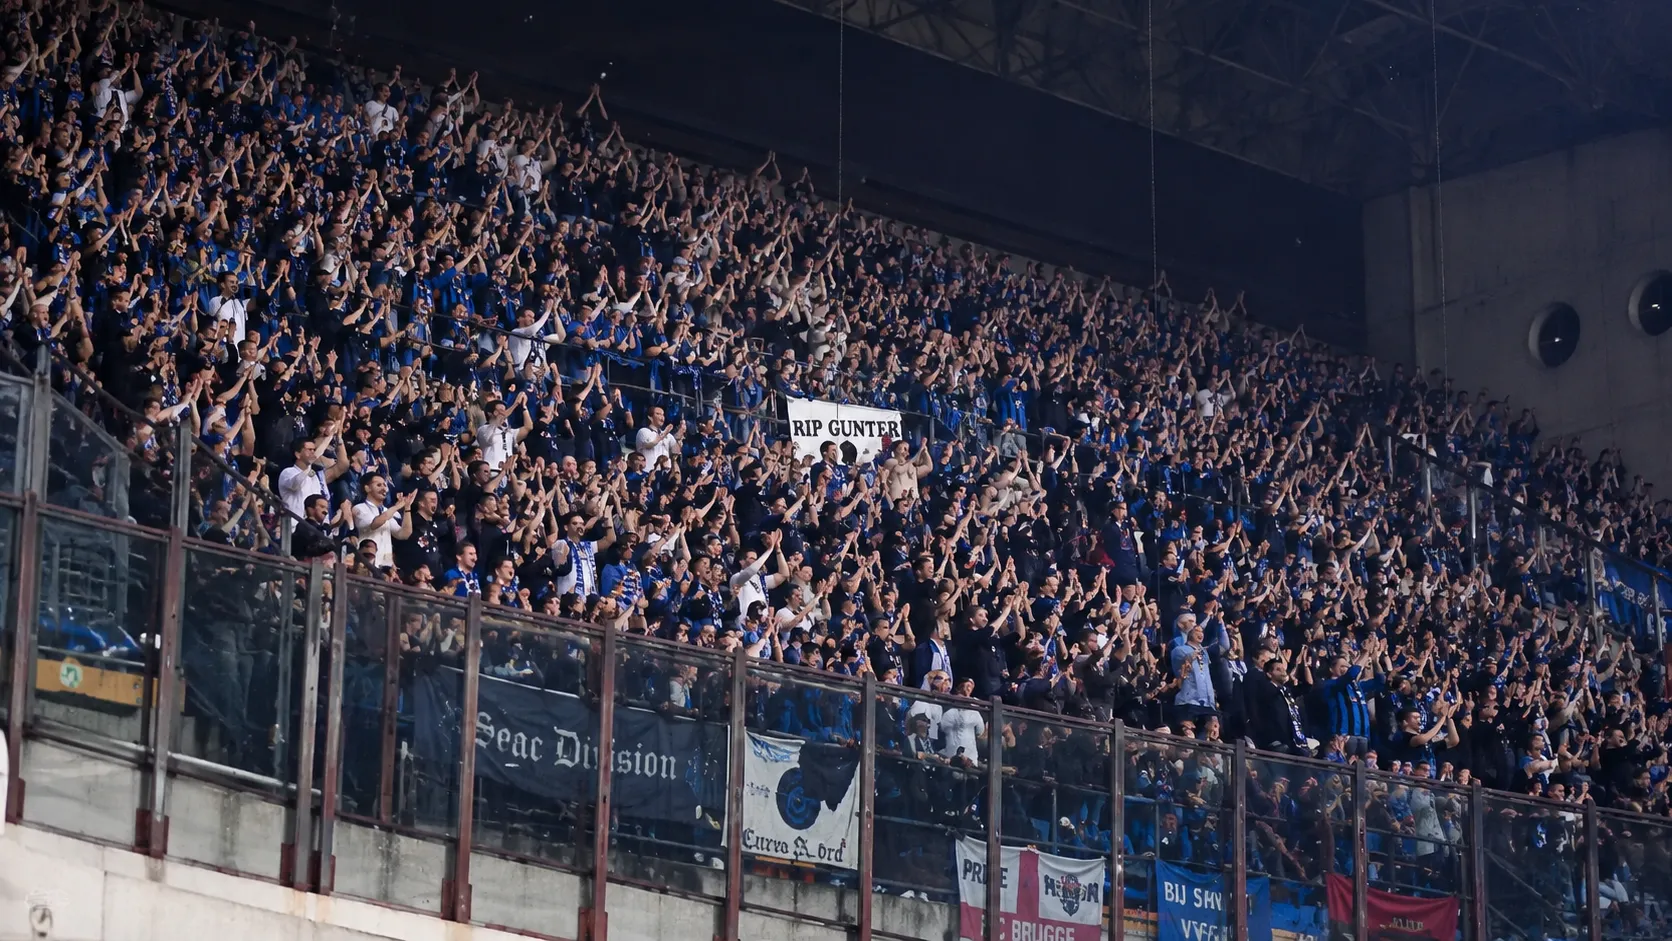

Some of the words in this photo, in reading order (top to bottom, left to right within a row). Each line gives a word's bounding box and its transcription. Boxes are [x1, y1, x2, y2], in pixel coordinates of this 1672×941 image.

[792, 419, 823, 437] RIP
[828, 419, 901, 438] GUNTER
[475, 711, 543, 762] Seac
[963, 858, 1008, 888] PRIE
[1164, 881, 1187, 906] BIJ
[1012, 920, 1075, 941] BRUGGE
